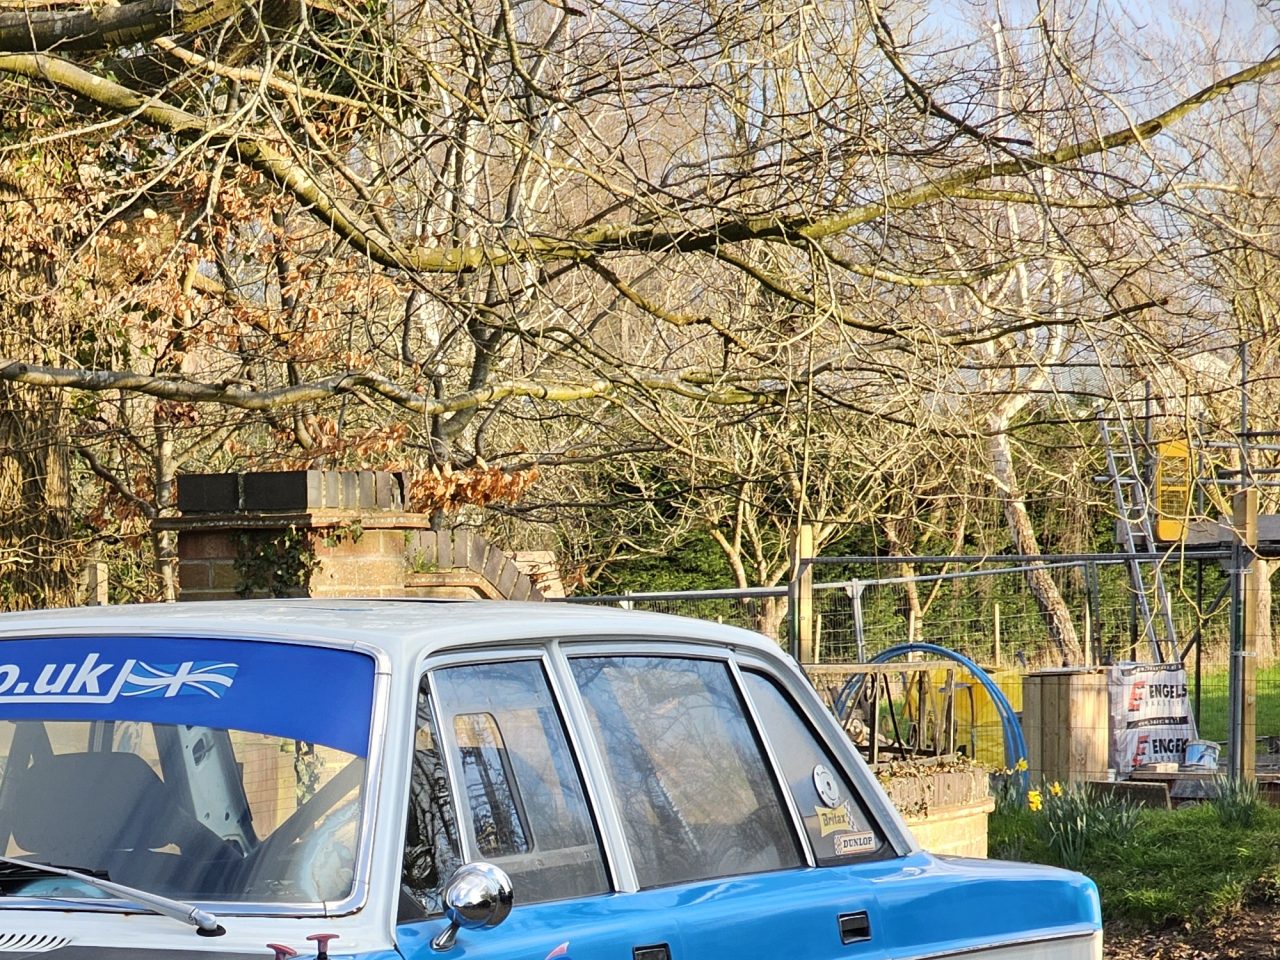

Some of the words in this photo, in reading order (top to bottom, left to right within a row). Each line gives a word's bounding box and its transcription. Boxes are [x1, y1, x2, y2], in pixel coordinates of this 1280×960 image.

[1149, 683, 1187, 698] ENGELS
[821, 812, 847, 827] Britax
[843, 836, 873, 848] DUNLOP
